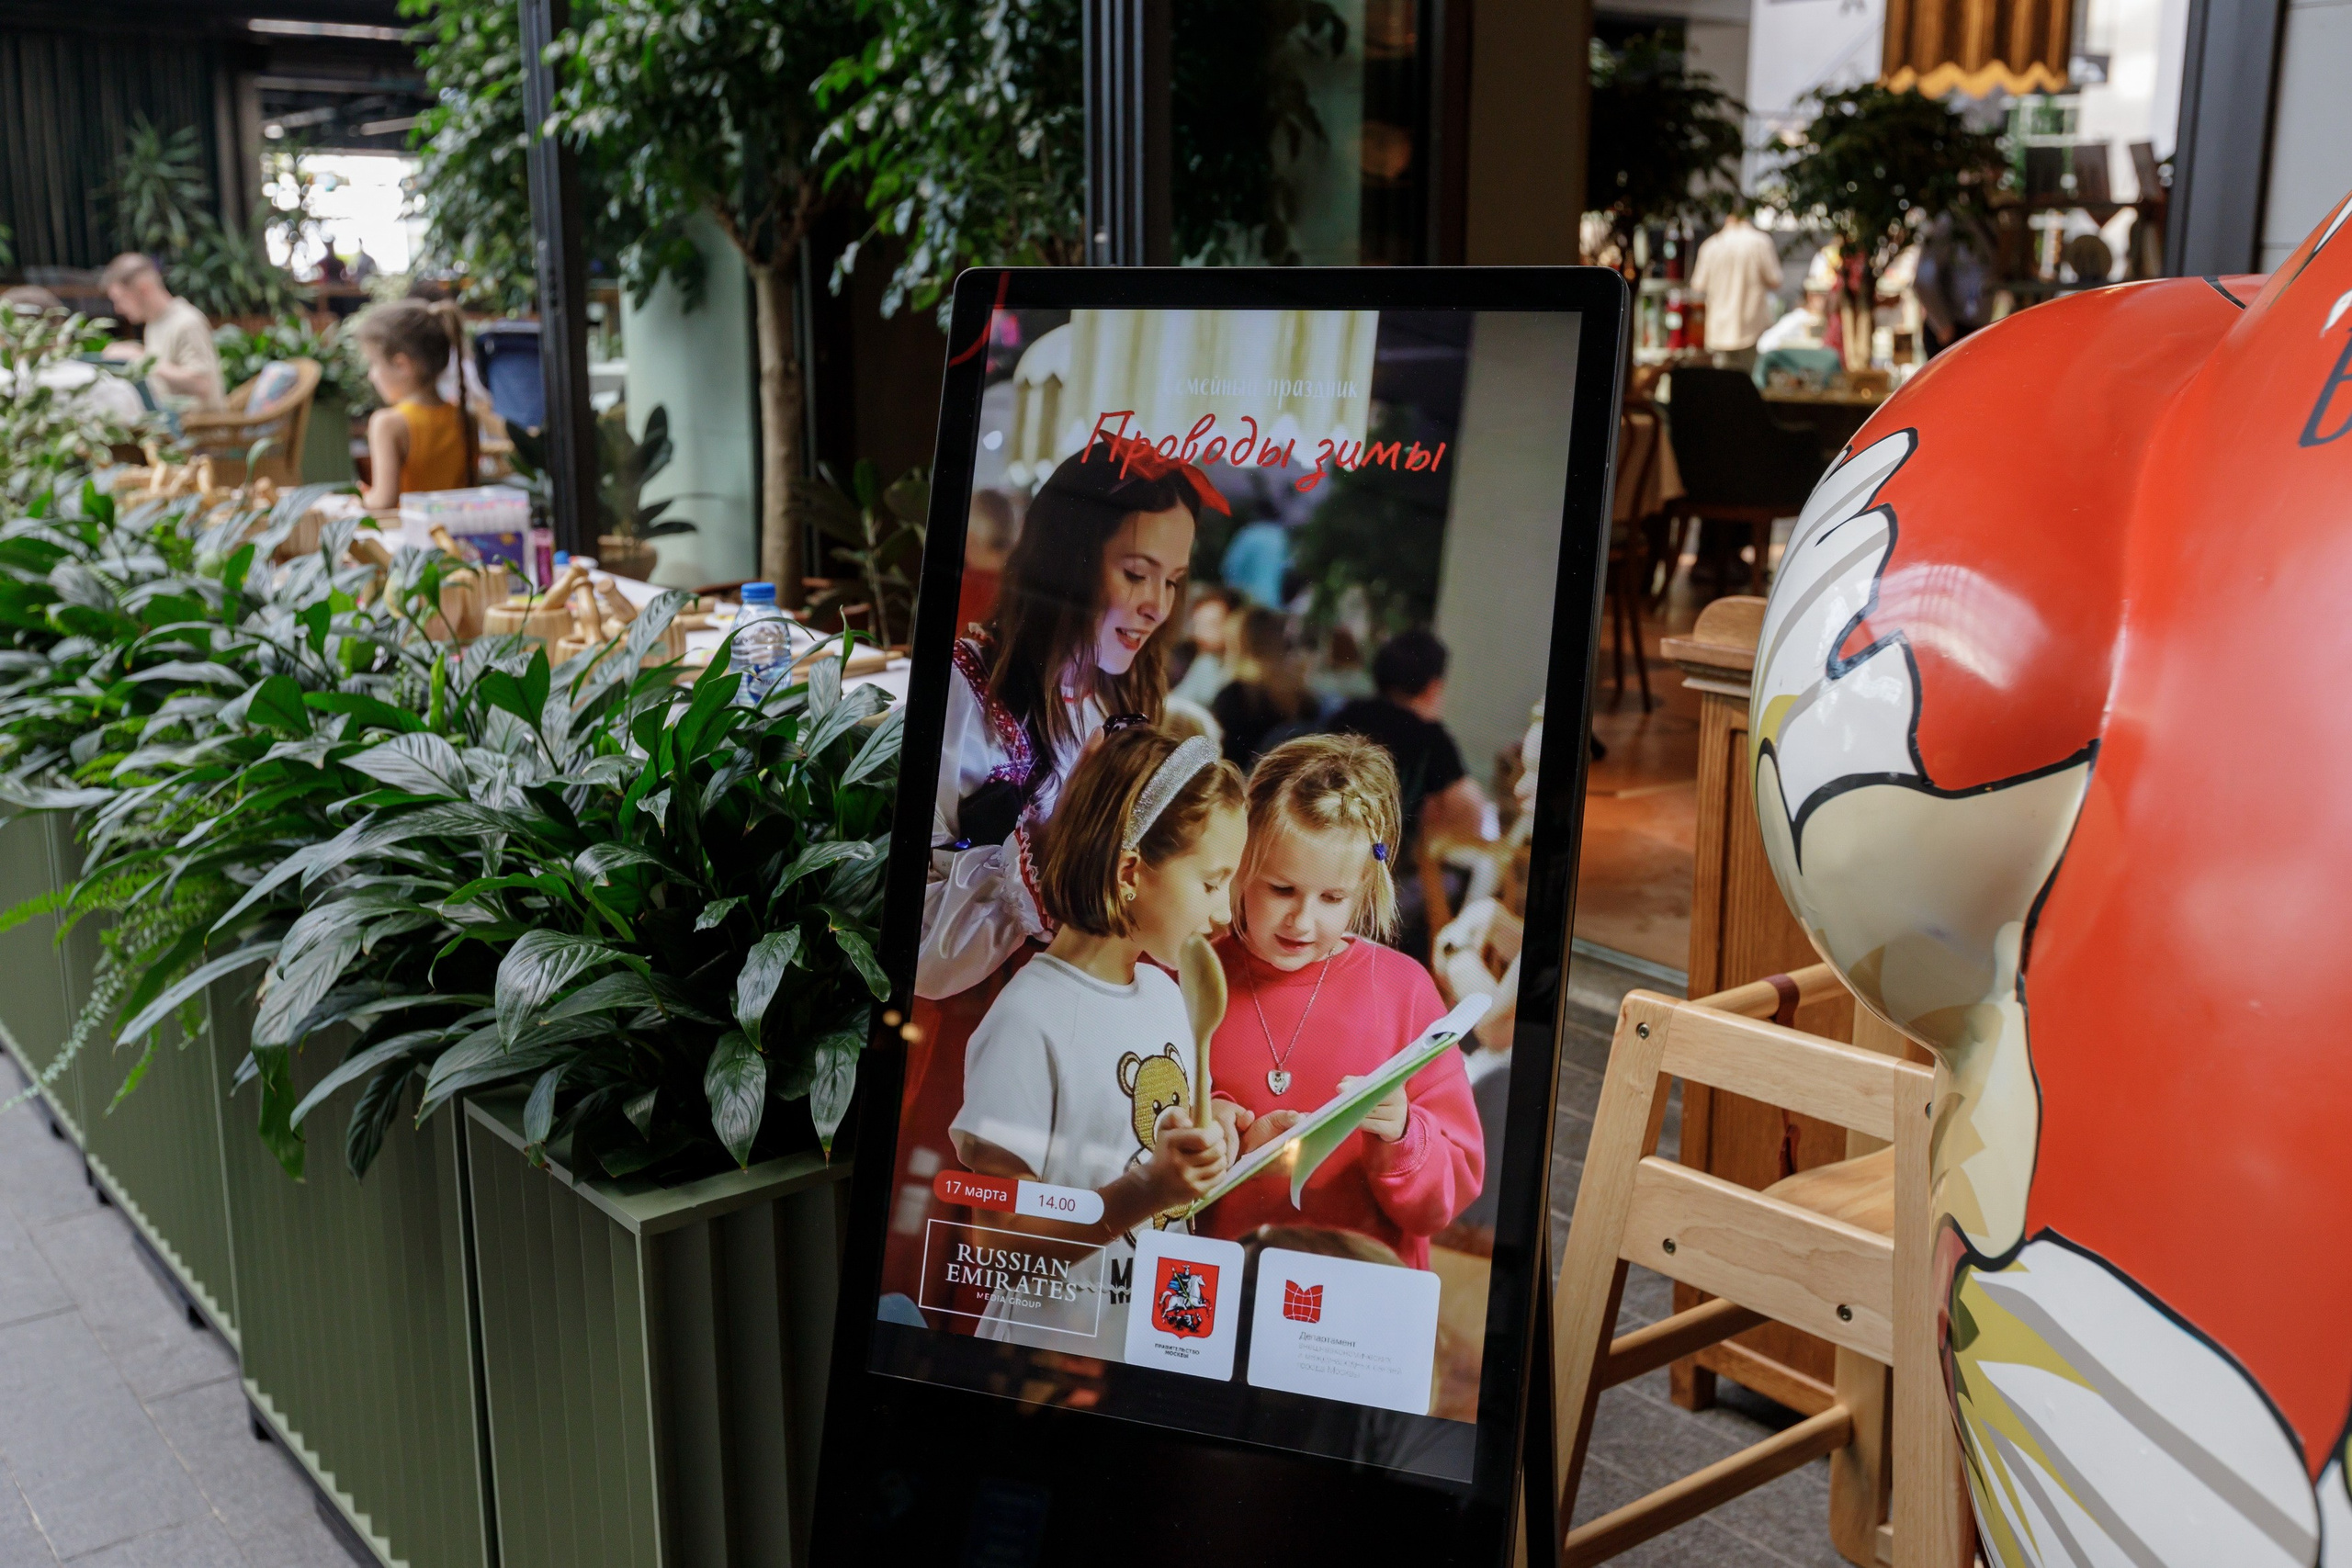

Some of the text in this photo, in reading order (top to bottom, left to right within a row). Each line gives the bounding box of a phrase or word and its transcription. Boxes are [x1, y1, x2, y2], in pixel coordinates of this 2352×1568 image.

[1267, 378, 1358, 410] праздник
[1080, 410, 1446, 493] Проводы зимы
[945, 1179, 1008, 1203] 17 марта
[1039, 1194, 1076, 1212] 14.00
[956, 1243, 1071, 1279] RUSSIAN
[945, 1263, 1078, 1303] EMIRATES
[977, 1292, 1042, 1309] MEDIA GROUP
